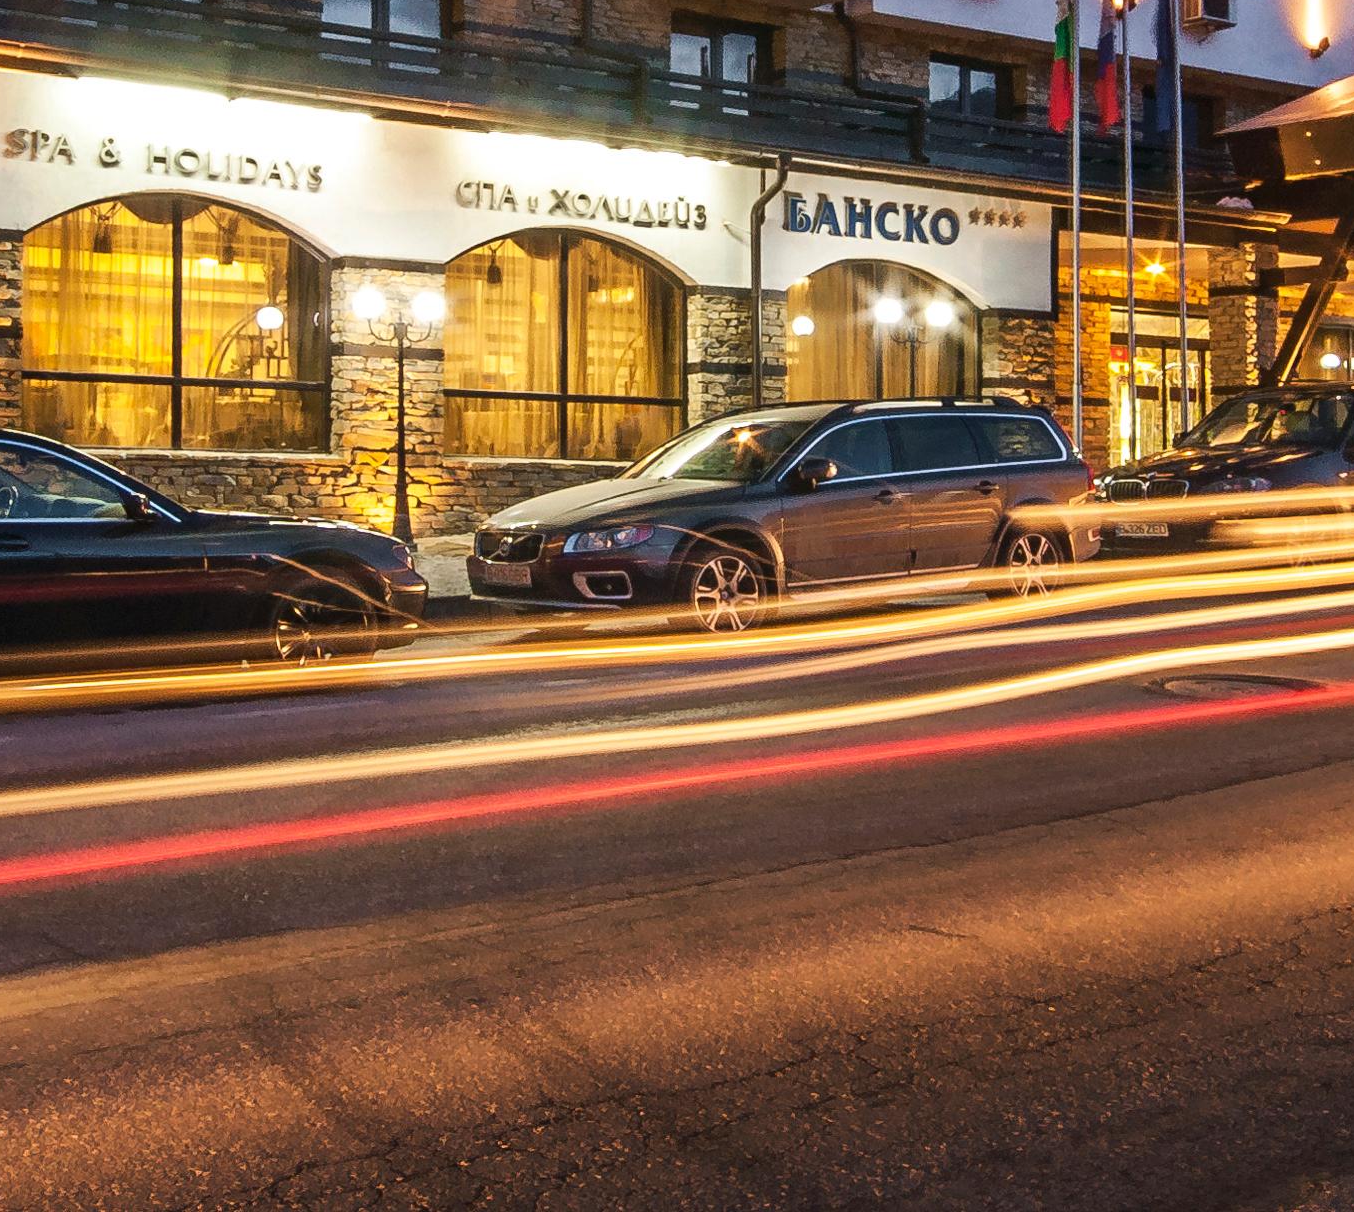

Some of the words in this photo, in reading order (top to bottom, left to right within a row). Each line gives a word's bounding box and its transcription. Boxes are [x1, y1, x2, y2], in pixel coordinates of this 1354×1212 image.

[2, 128, 77, 165] SPA
[100, 137, 122, 168] &
[145, 142, 324, 192] HOLIDAYS
[455, 179, 520, 212] СПА
[782, 190, 960, 246] БАНСКО
